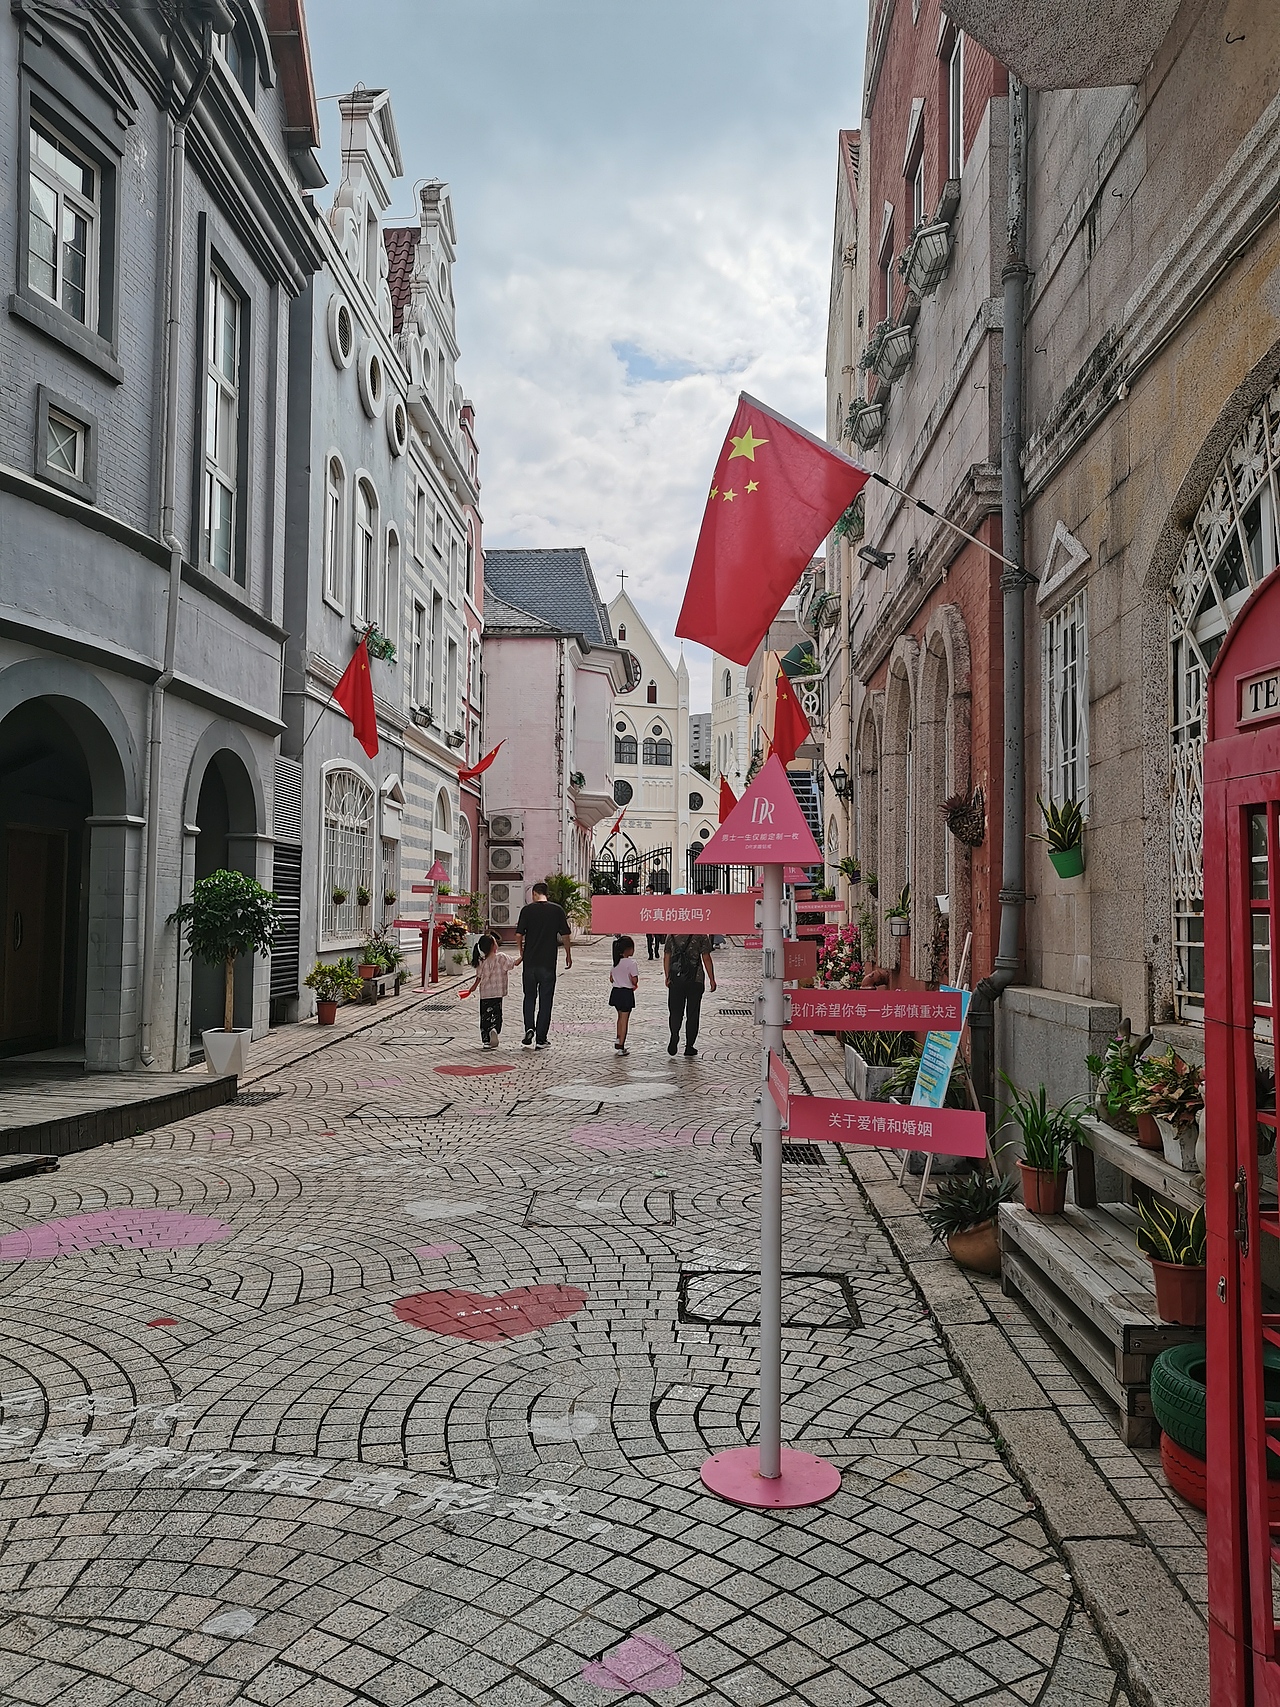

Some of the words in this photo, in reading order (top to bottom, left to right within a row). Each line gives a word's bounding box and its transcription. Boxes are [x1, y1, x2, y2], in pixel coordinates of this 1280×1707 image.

[1250, 676, 1280, 713] TE
[751, 796, 775, 825] DR
[721, 832, 800, 842] 男士一生仅能定制一枚
[639, 907, 712, 922] 你真的敢吗?
[791, 1003, 957, 1020] 我们希望你每一步都慎重决定
[828, 1112, 933, 1138] 关于爱情和婚姻
